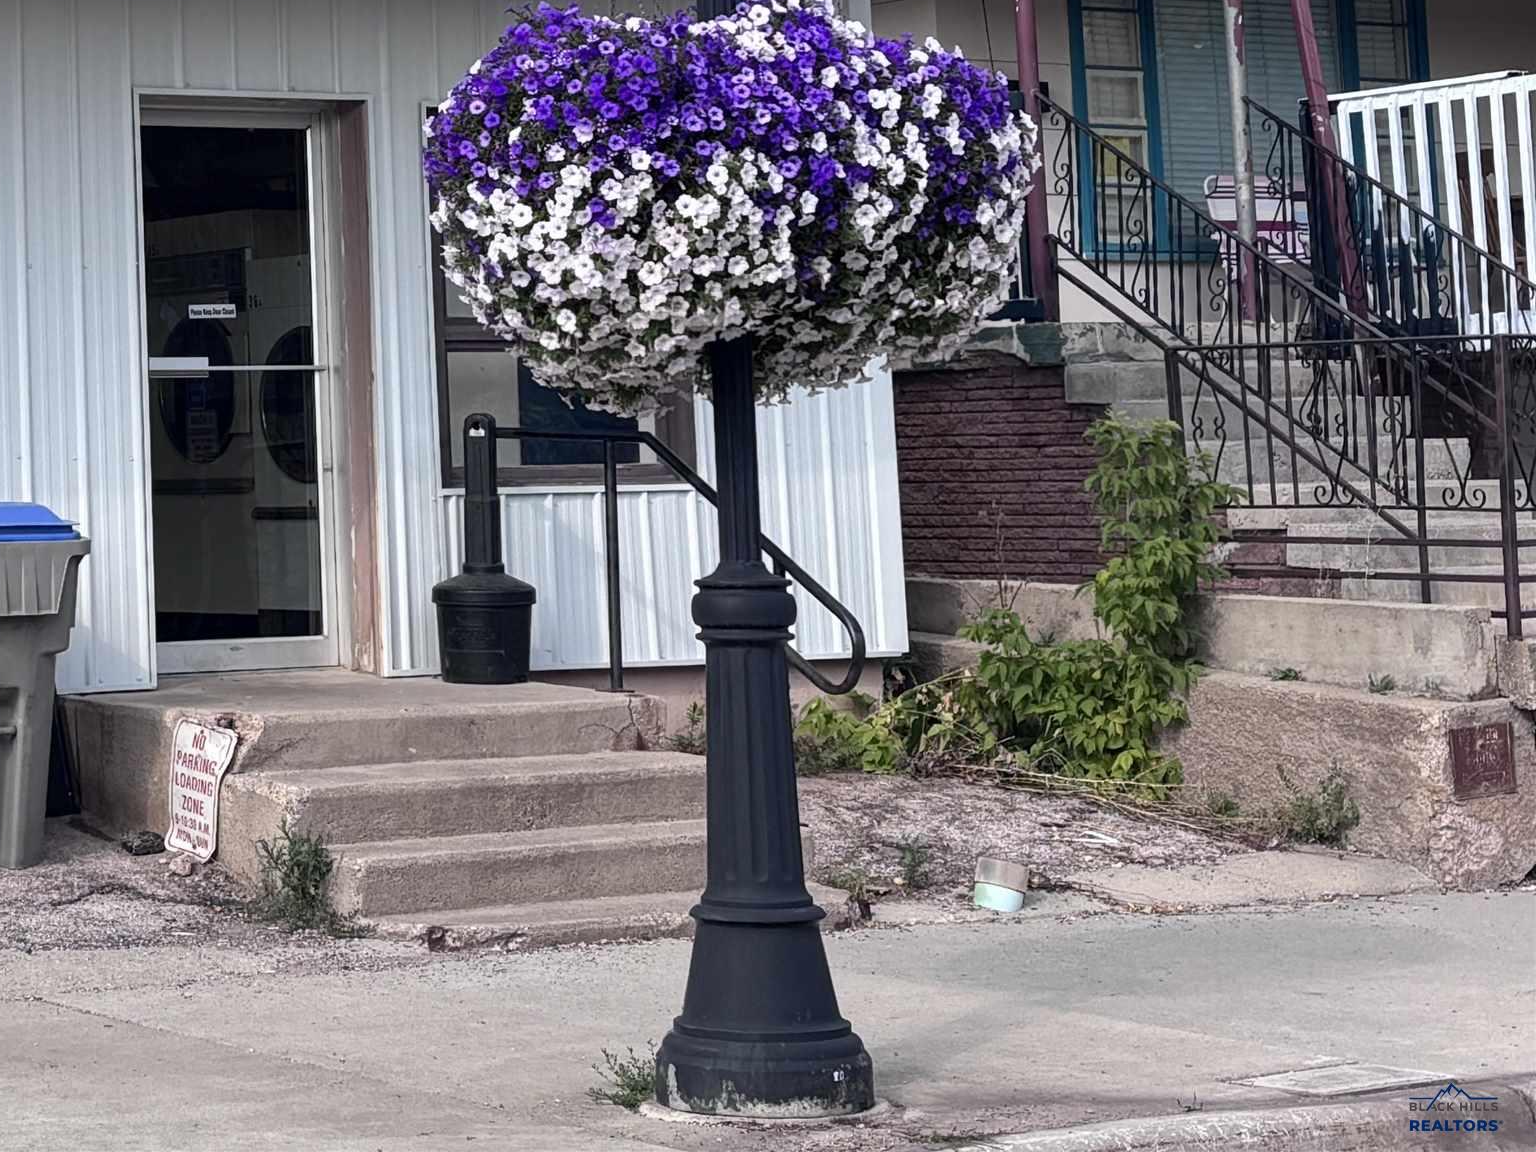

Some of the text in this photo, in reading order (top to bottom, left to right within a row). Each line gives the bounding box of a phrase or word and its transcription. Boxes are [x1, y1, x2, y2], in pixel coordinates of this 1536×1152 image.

[191, 733, 207, 750] NO
[175, 750, 217, 777] PARKING
[175, 772, 214, 797] LOADING
[181, 794, 205, 816] ZONE
